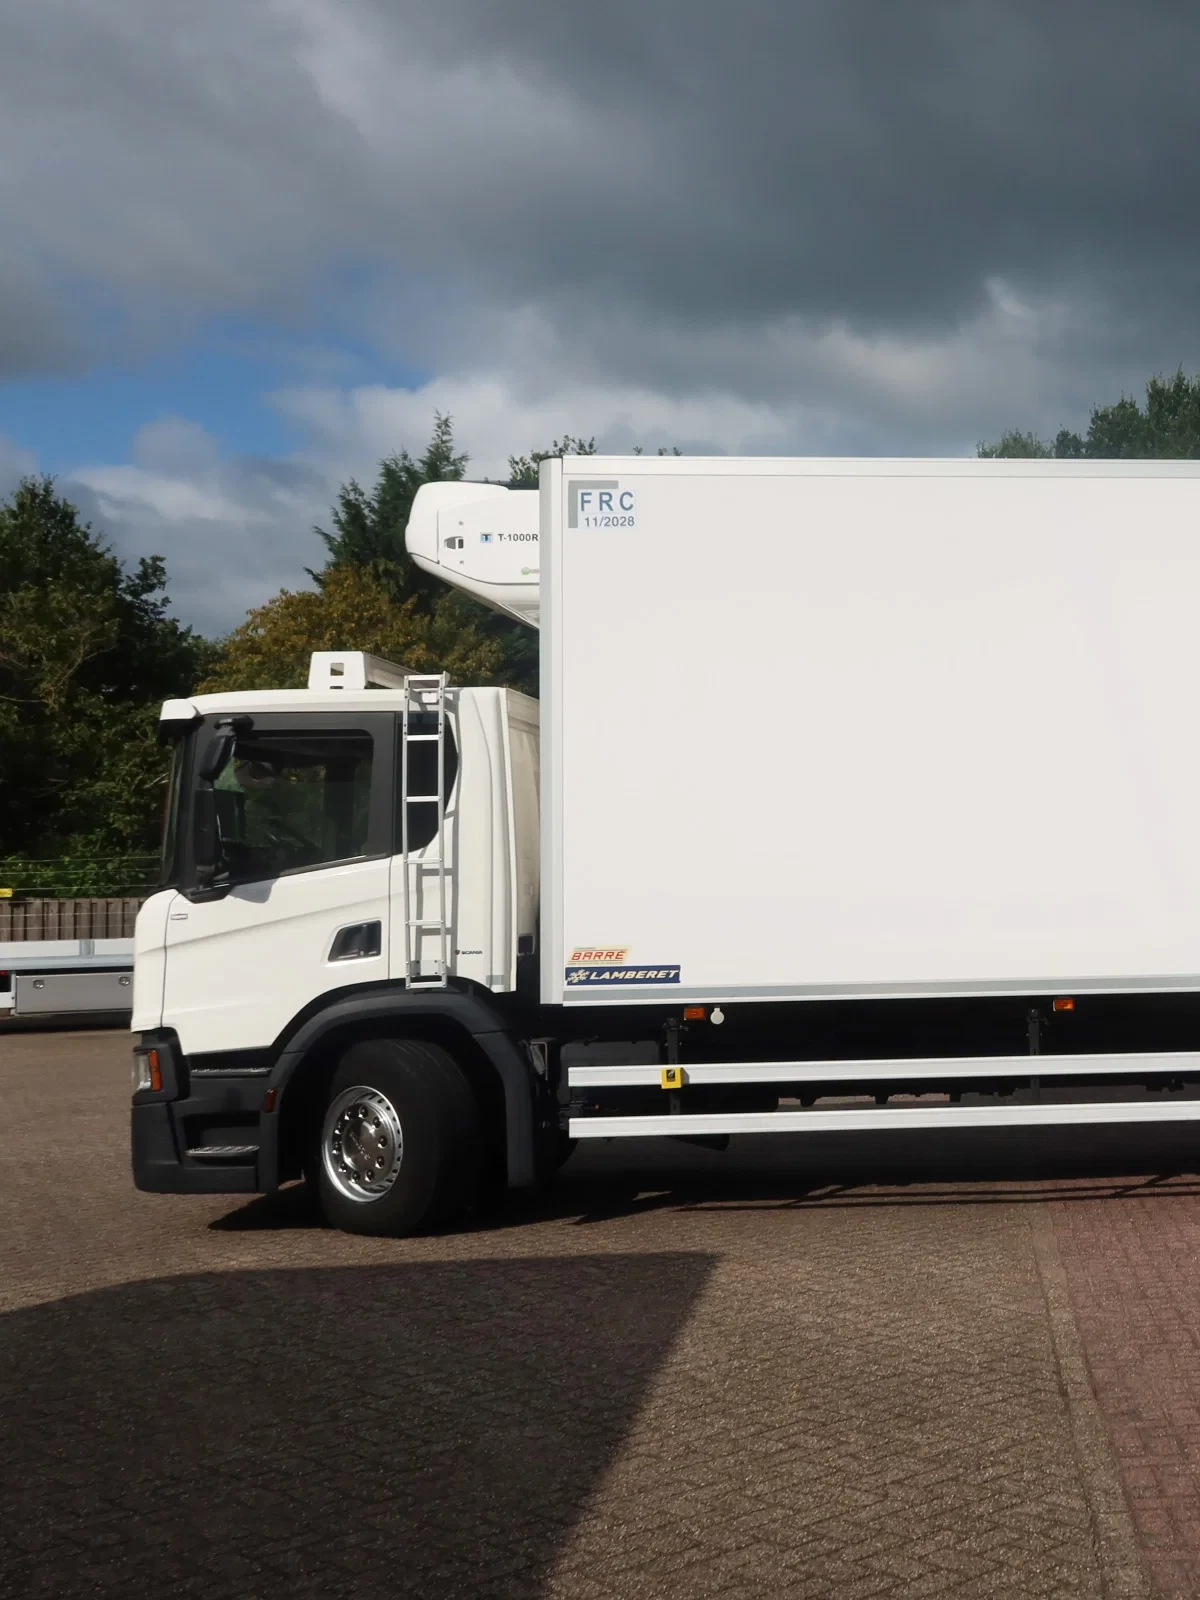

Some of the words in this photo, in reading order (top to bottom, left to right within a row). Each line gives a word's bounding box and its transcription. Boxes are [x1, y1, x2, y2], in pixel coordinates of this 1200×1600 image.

[580, 491, 634, 511] FRC
[584, 515, 635, 527] 11/2028
[497, 533, 539, 541] T-1000R
[589, 969, 680, 980] LAMBERET
